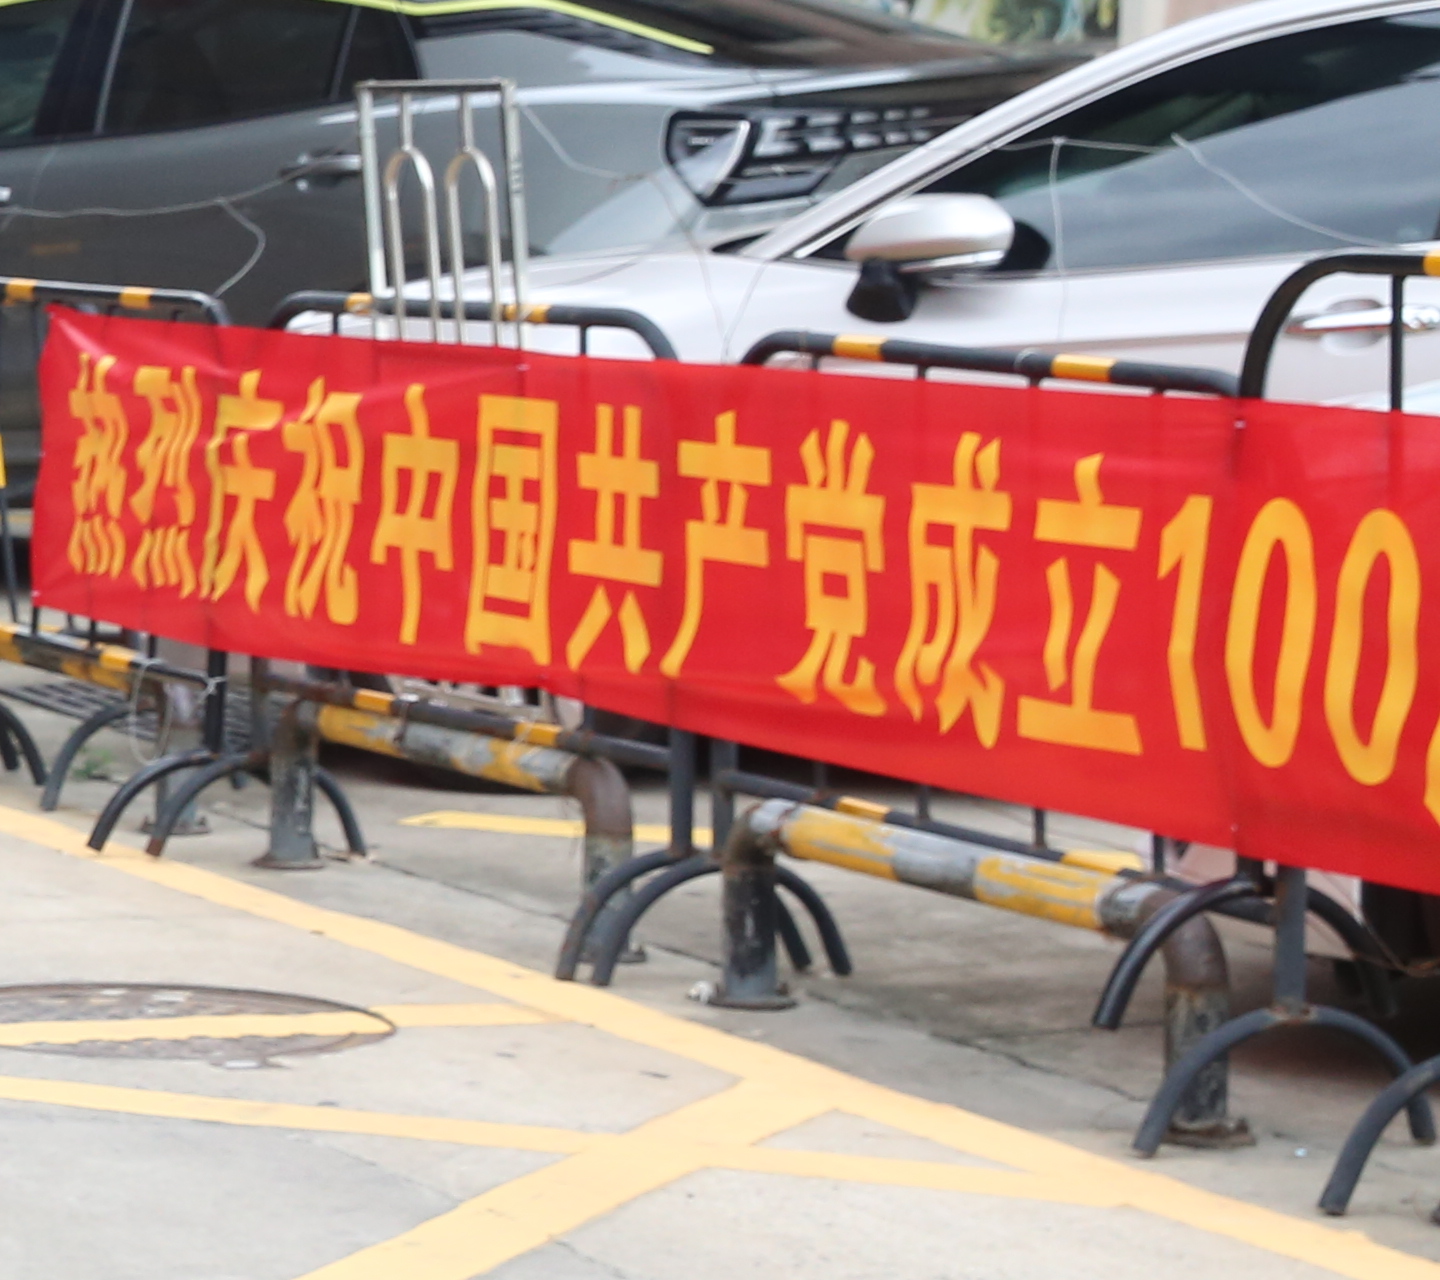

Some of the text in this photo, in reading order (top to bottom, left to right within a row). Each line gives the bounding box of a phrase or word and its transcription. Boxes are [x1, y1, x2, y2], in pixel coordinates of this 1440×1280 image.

[68, 352, 1440, 827] 热烈庆祝中国共产党成立100
